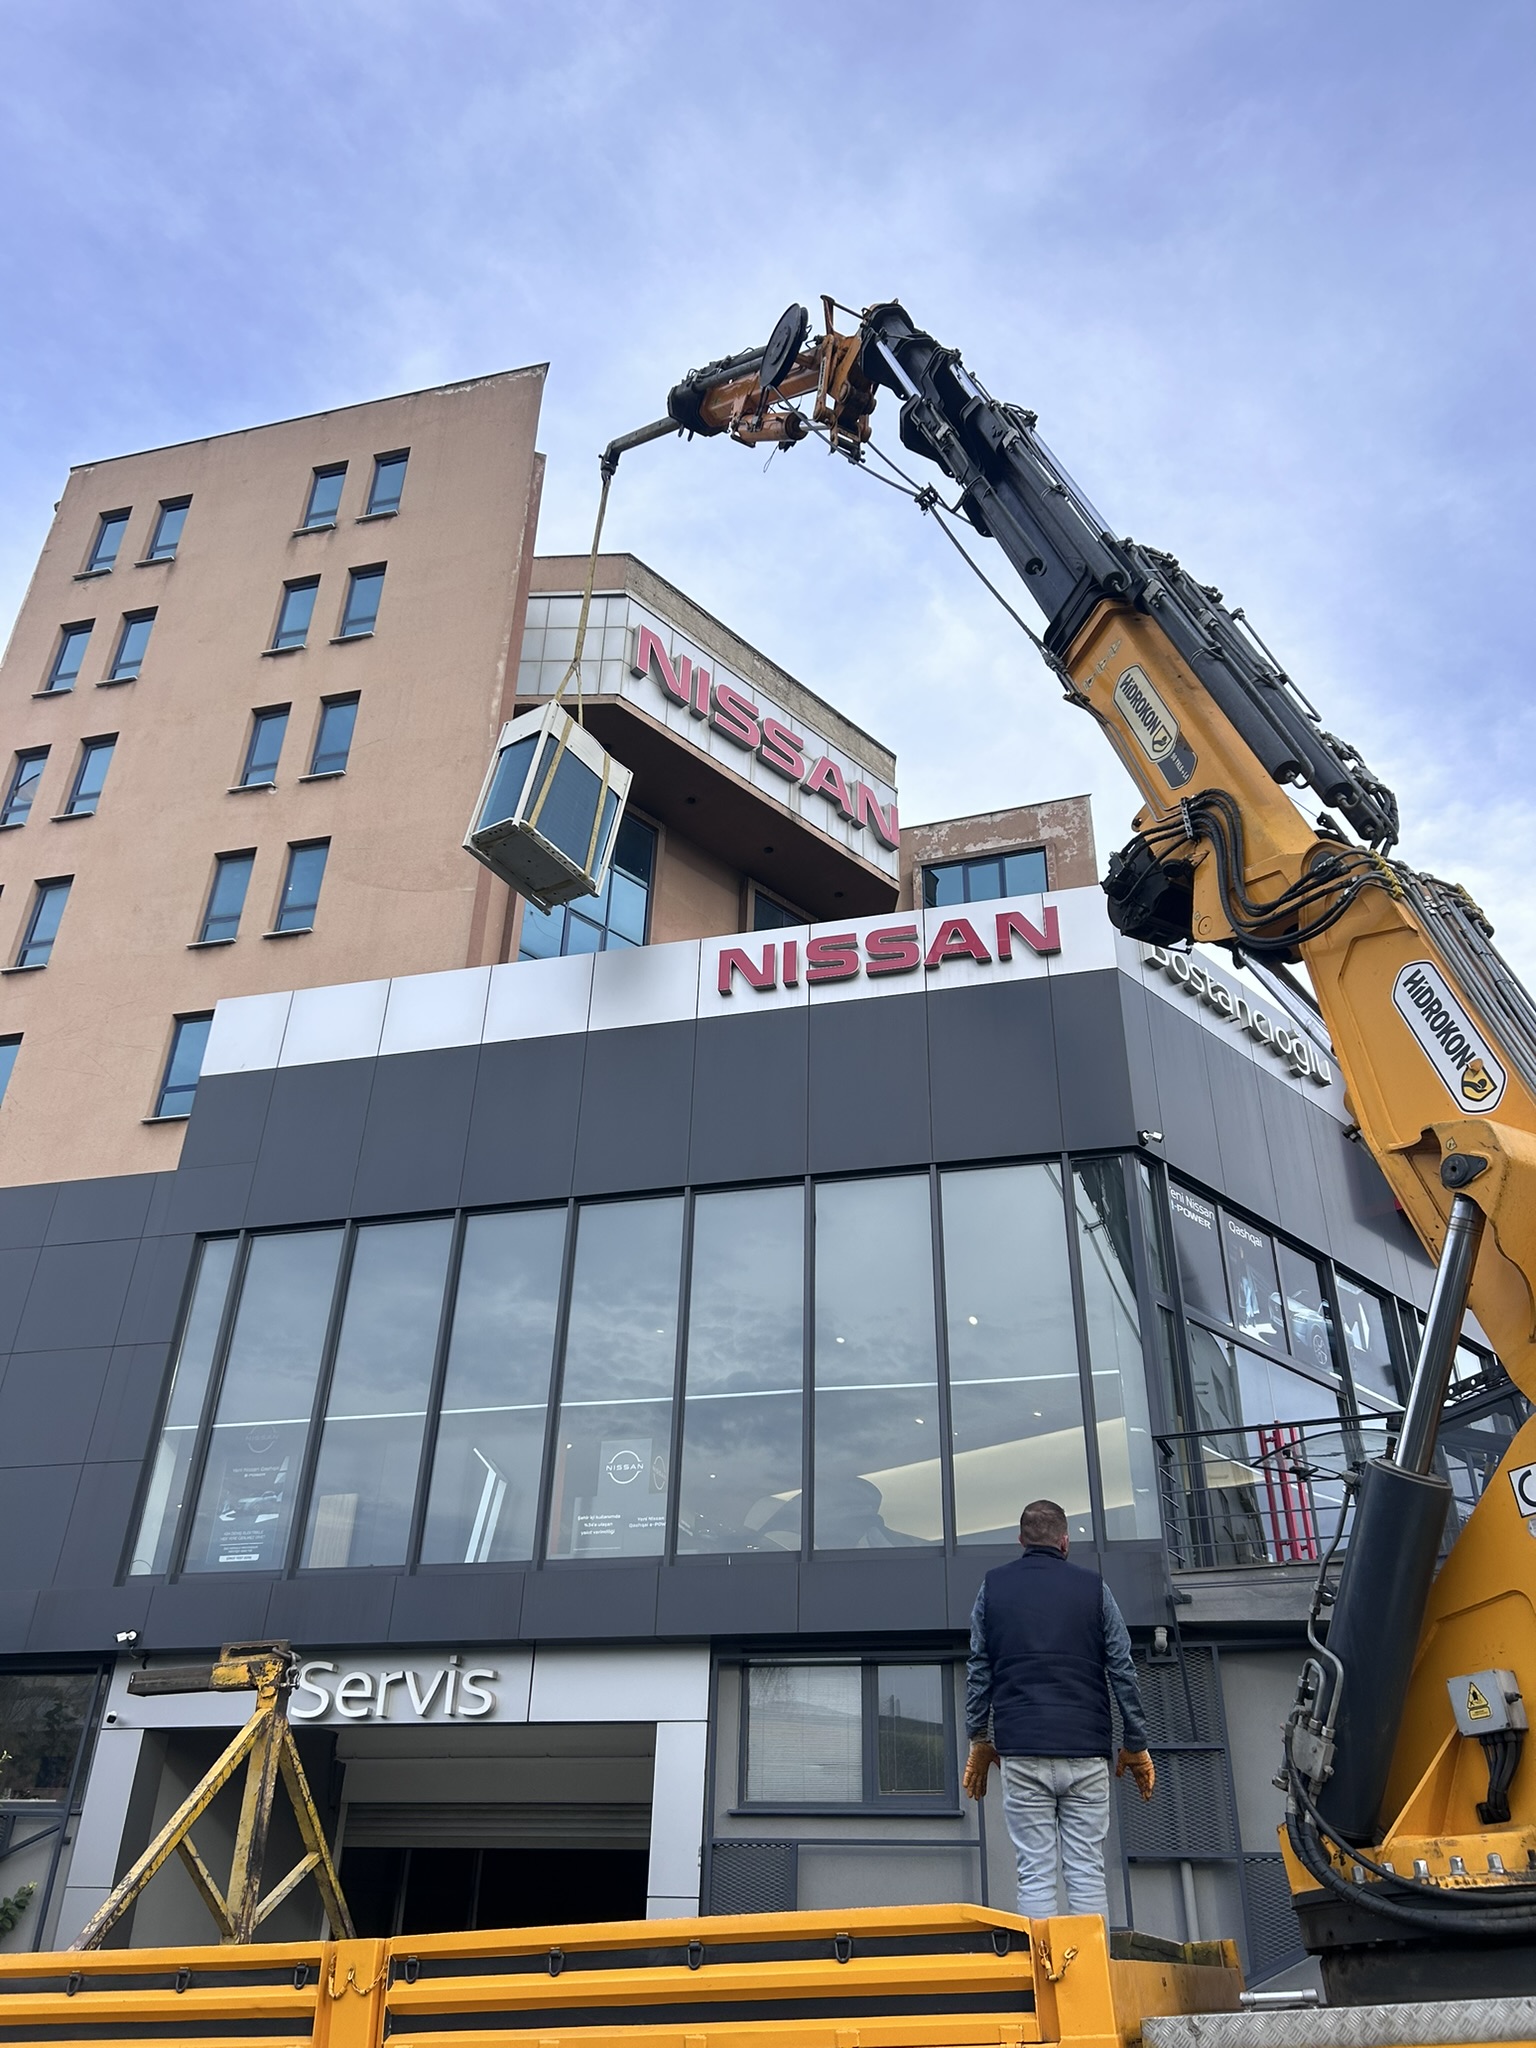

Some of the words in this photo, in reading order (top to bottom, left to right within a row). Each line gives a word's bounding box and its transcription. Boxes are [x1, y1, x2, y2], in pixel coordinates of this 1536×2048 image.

[630, 624, 900, 852] NISSAN
[718, 905, 1062, 995] NISSAN
[1169, 1186, 1185, 1204] eni
[1185, 1195, 1216, 1221] Nissan
[1228, 1220, 1263, 1248] Qashqai
[605, 1463, 644, 1471] NISSAN
[290, 1654, 499, 1719] Servis
